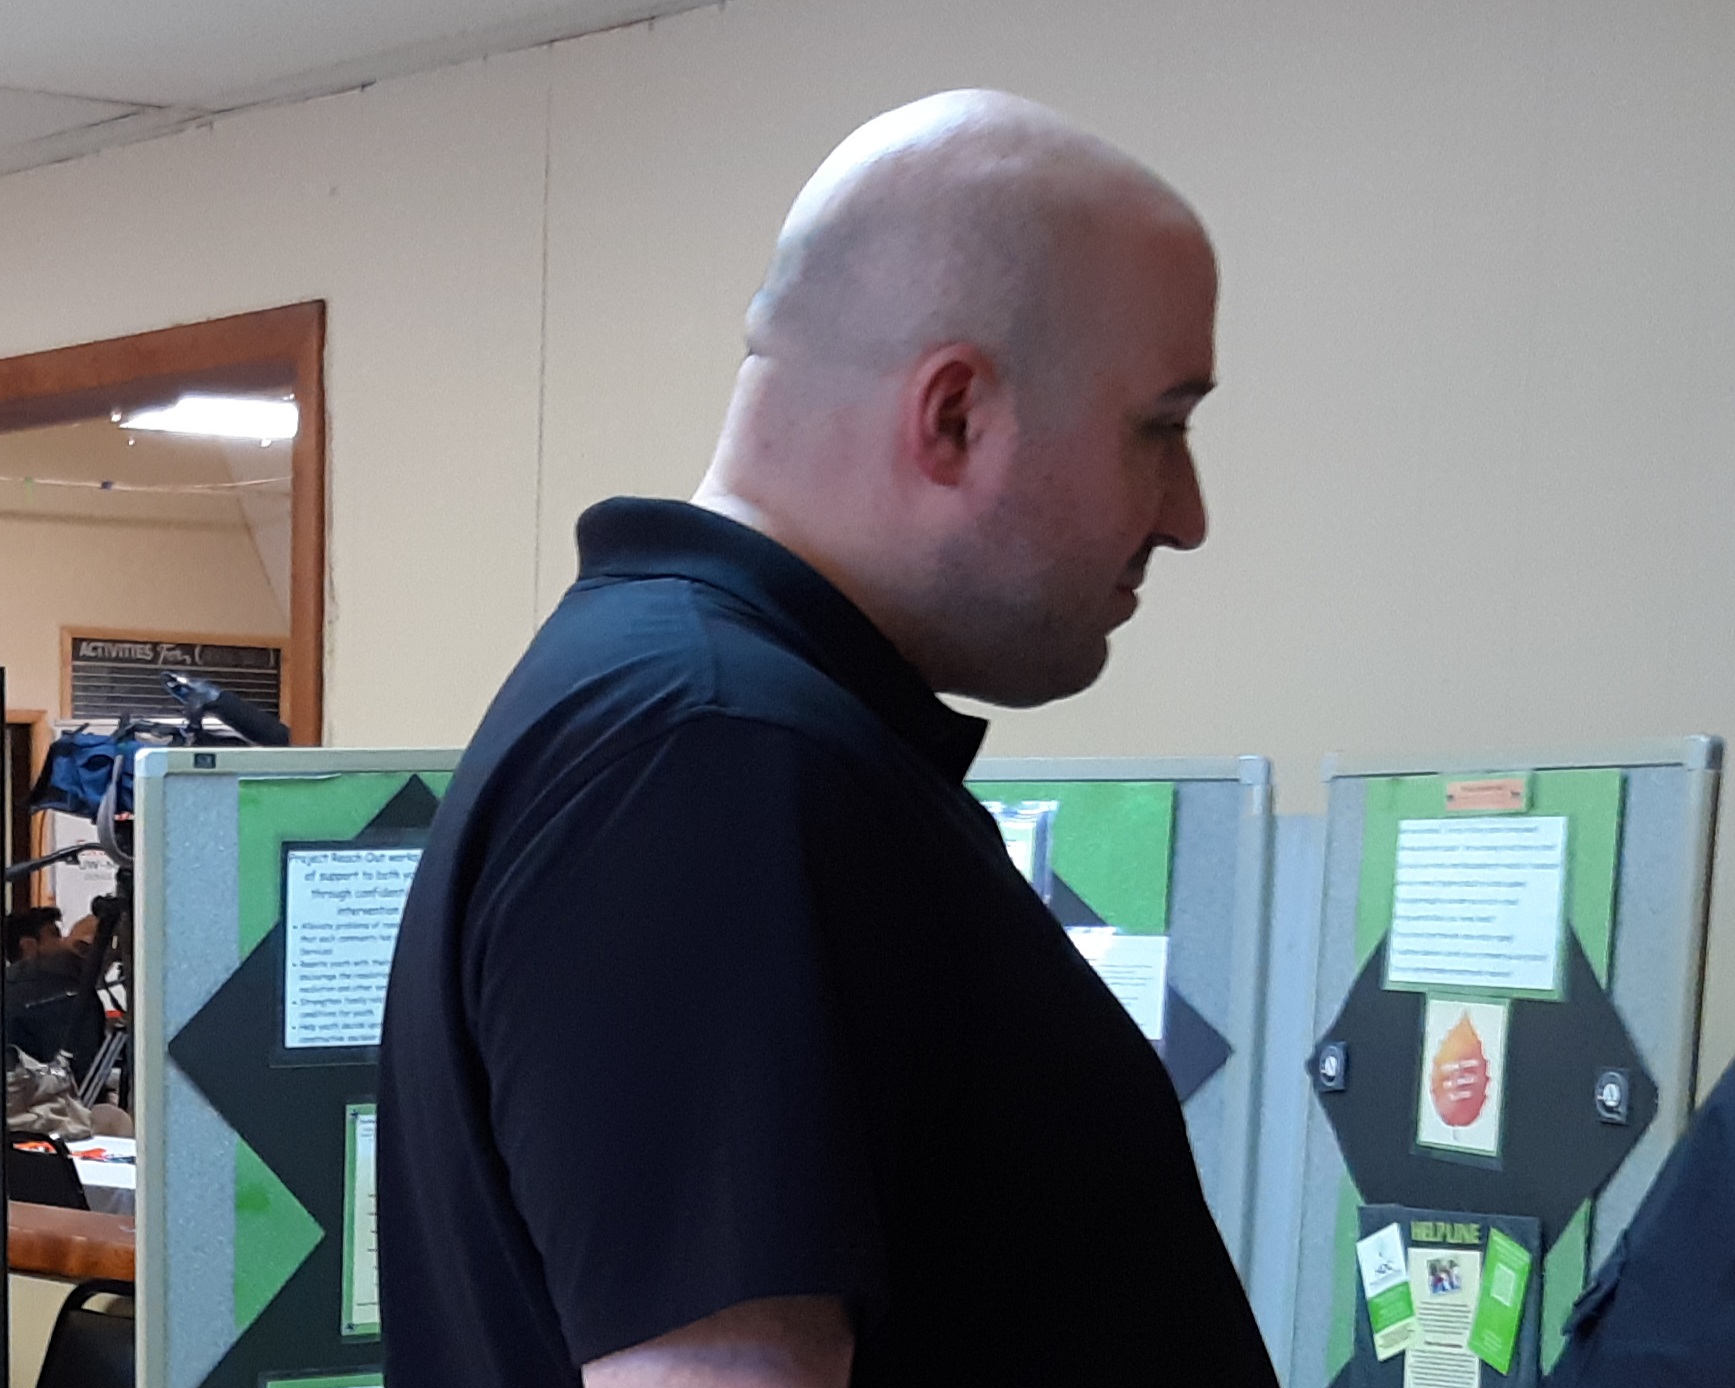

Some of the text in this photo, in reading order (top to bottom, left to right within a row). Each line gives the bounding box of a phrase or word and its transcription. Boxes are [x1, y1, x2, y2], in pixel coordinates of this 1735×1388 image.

[78, 641, 154, 661] ACTIVITIES
[288, 852, 329, 866] Project
[331, 852, 362, 863] Reach
[364, 852, 386, 863] Out
[319, 871, 359, 882] support
